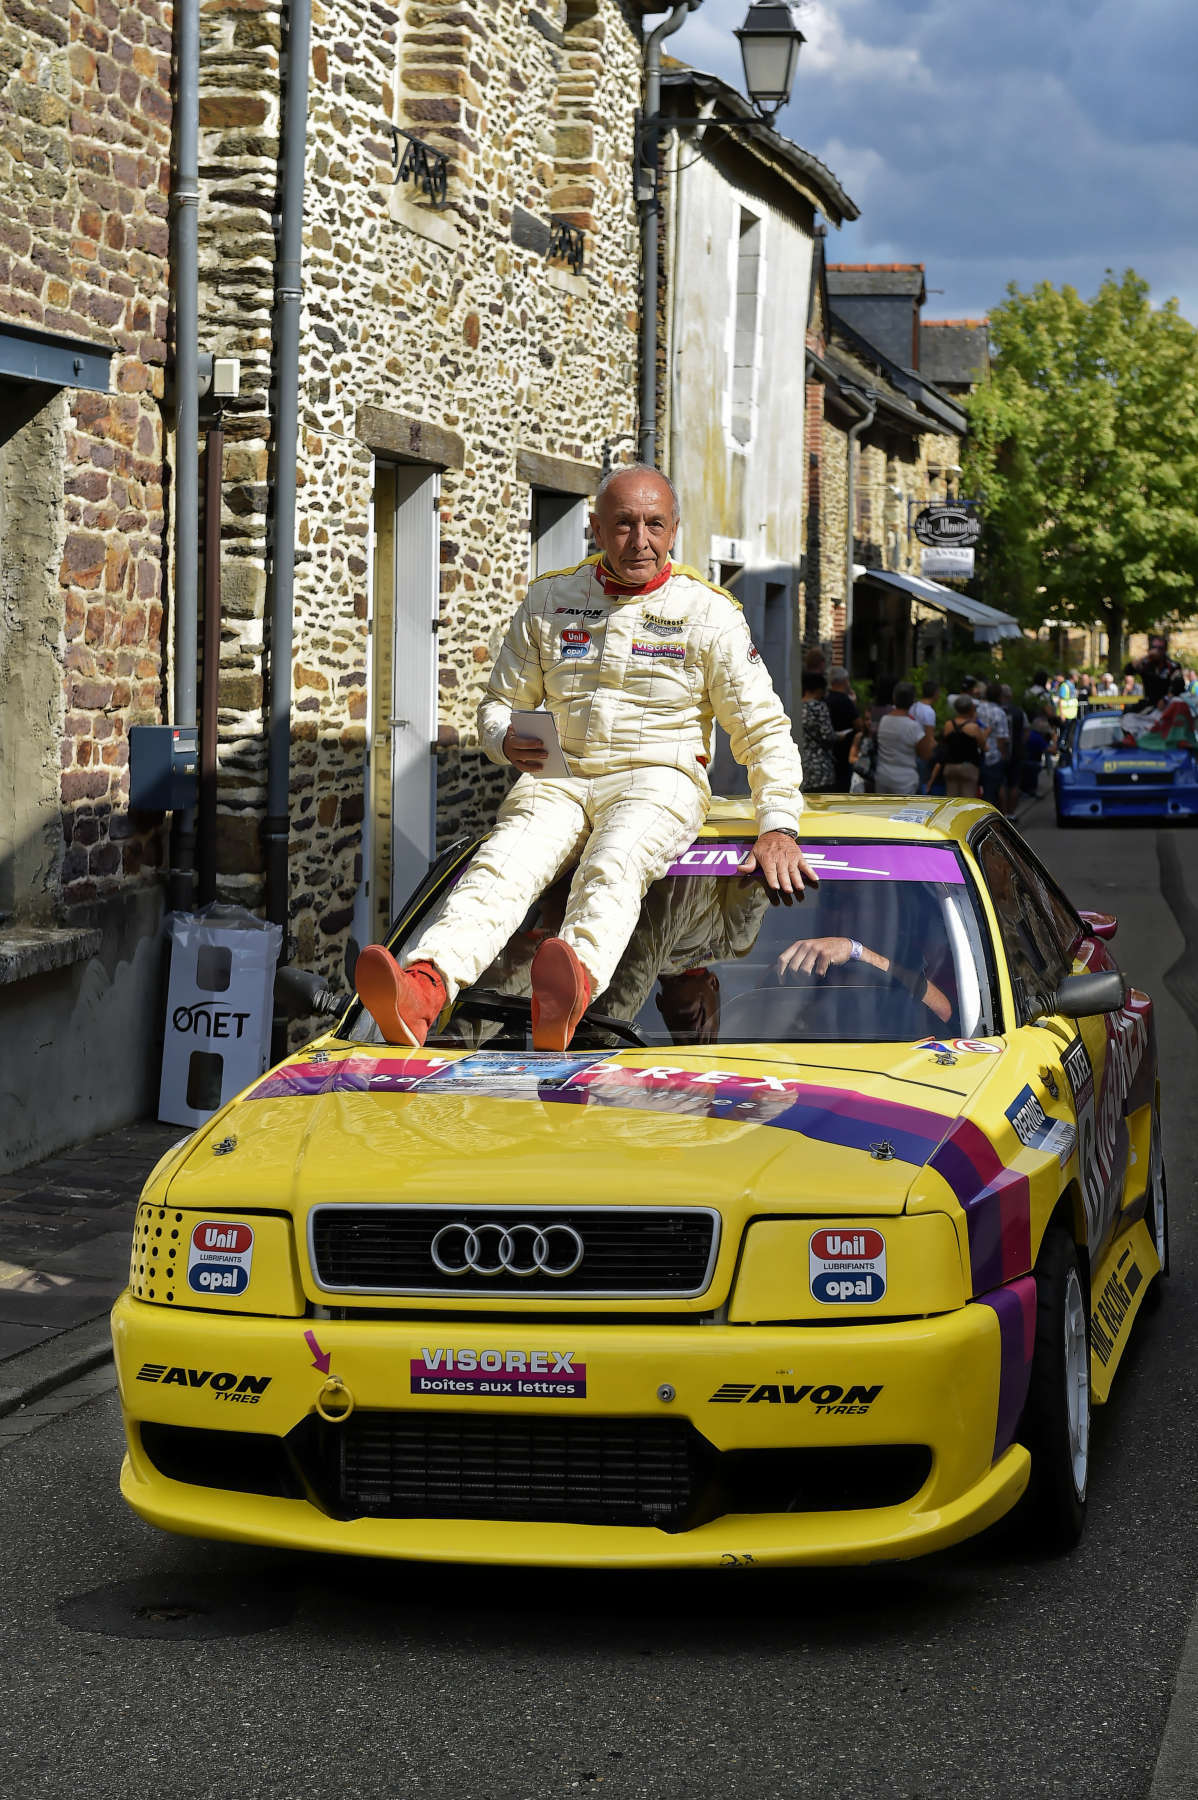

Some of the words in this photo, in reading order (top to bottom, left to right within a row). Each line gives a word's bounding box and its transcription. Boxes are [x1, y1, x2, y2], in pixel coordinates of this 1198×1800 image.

[565, 609, 603, 617] AVON
[568, 632, 583, 641] Unil
[566, 648, 583, 656] opal
[1068, 1047, 1091, 1094] AXEL
[1012, 1095, 1046, 1145] BERNIS
[205, 1228, 238, 1249] Unil
[826, 1235, 866, 1255] Unil
[200, 1254, 242, 1263] LUBRIFIANTS
[823, 1262, 875, 1270] LUBRIFIANTS
[199, 1268, 238, 1290] opal
[825, 1275, 872, 1300] opal
[1098, 1271, 1131, 1338] RACING
[421, 1347, 575, 1374] VISOREX
[161, 1367, 273, 1395] AVON
[420, 1377, 475, 1391] boîtes
[479, 1381, 512, 1392] aux
[518, 1380, 576, 1394] lettres
[214, 1391, 262, 1404] TYRES
[746, 1385, 885, 1404] AVON
[814, 1405, 870, 1415] TYRES
